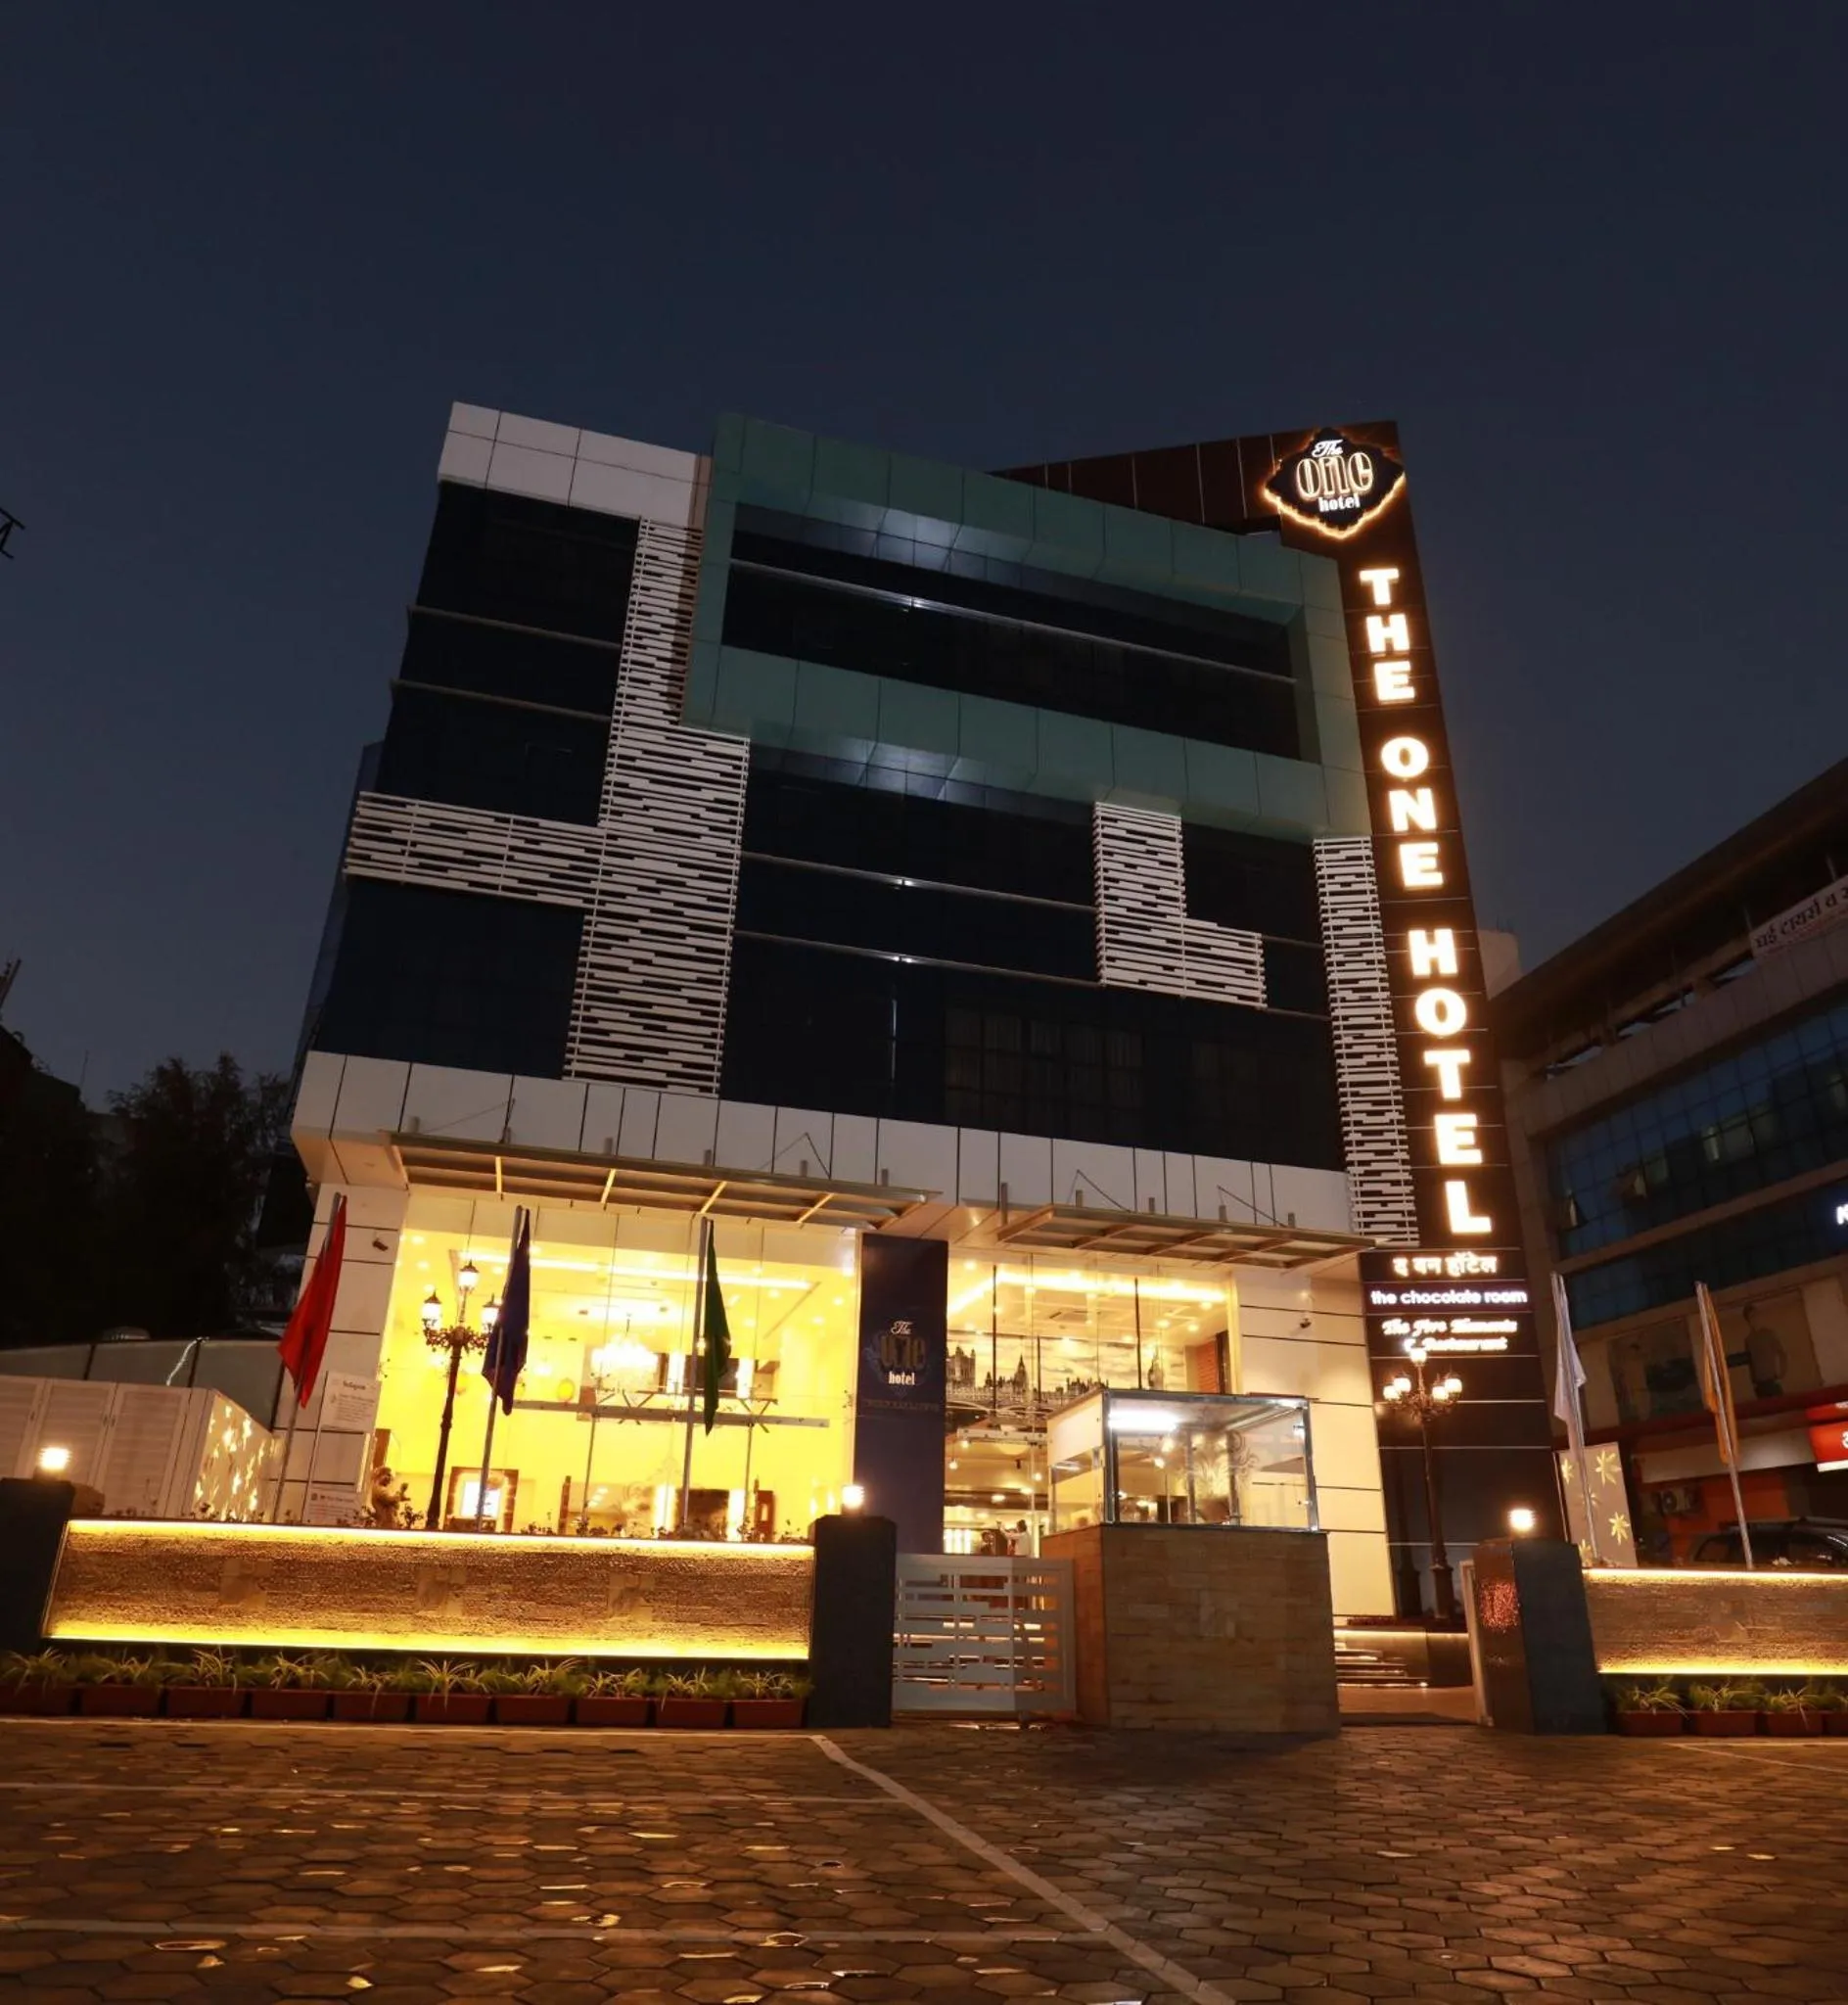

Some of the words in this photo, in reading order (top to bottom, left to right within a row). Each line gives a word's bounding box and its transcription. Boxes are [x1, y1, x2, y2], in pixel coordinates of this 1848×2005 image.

[1312, 439, 1344, 457] The
[1318, 493, 1361, 512] hotel
[1360, 568, 1415, 701] THE
[1381, 736, 1444, 887] ONE
[1409, 928, 1492, 1234] HOTEL
[1371, 1290, 1397, 1304] the
[1401, 1289, 1481, 1304] chocolate
[1484, 1290, 1527, 1303] room
[891, 1321, 912, 1334] The
[889, 1372, 915, 1385] hotel
